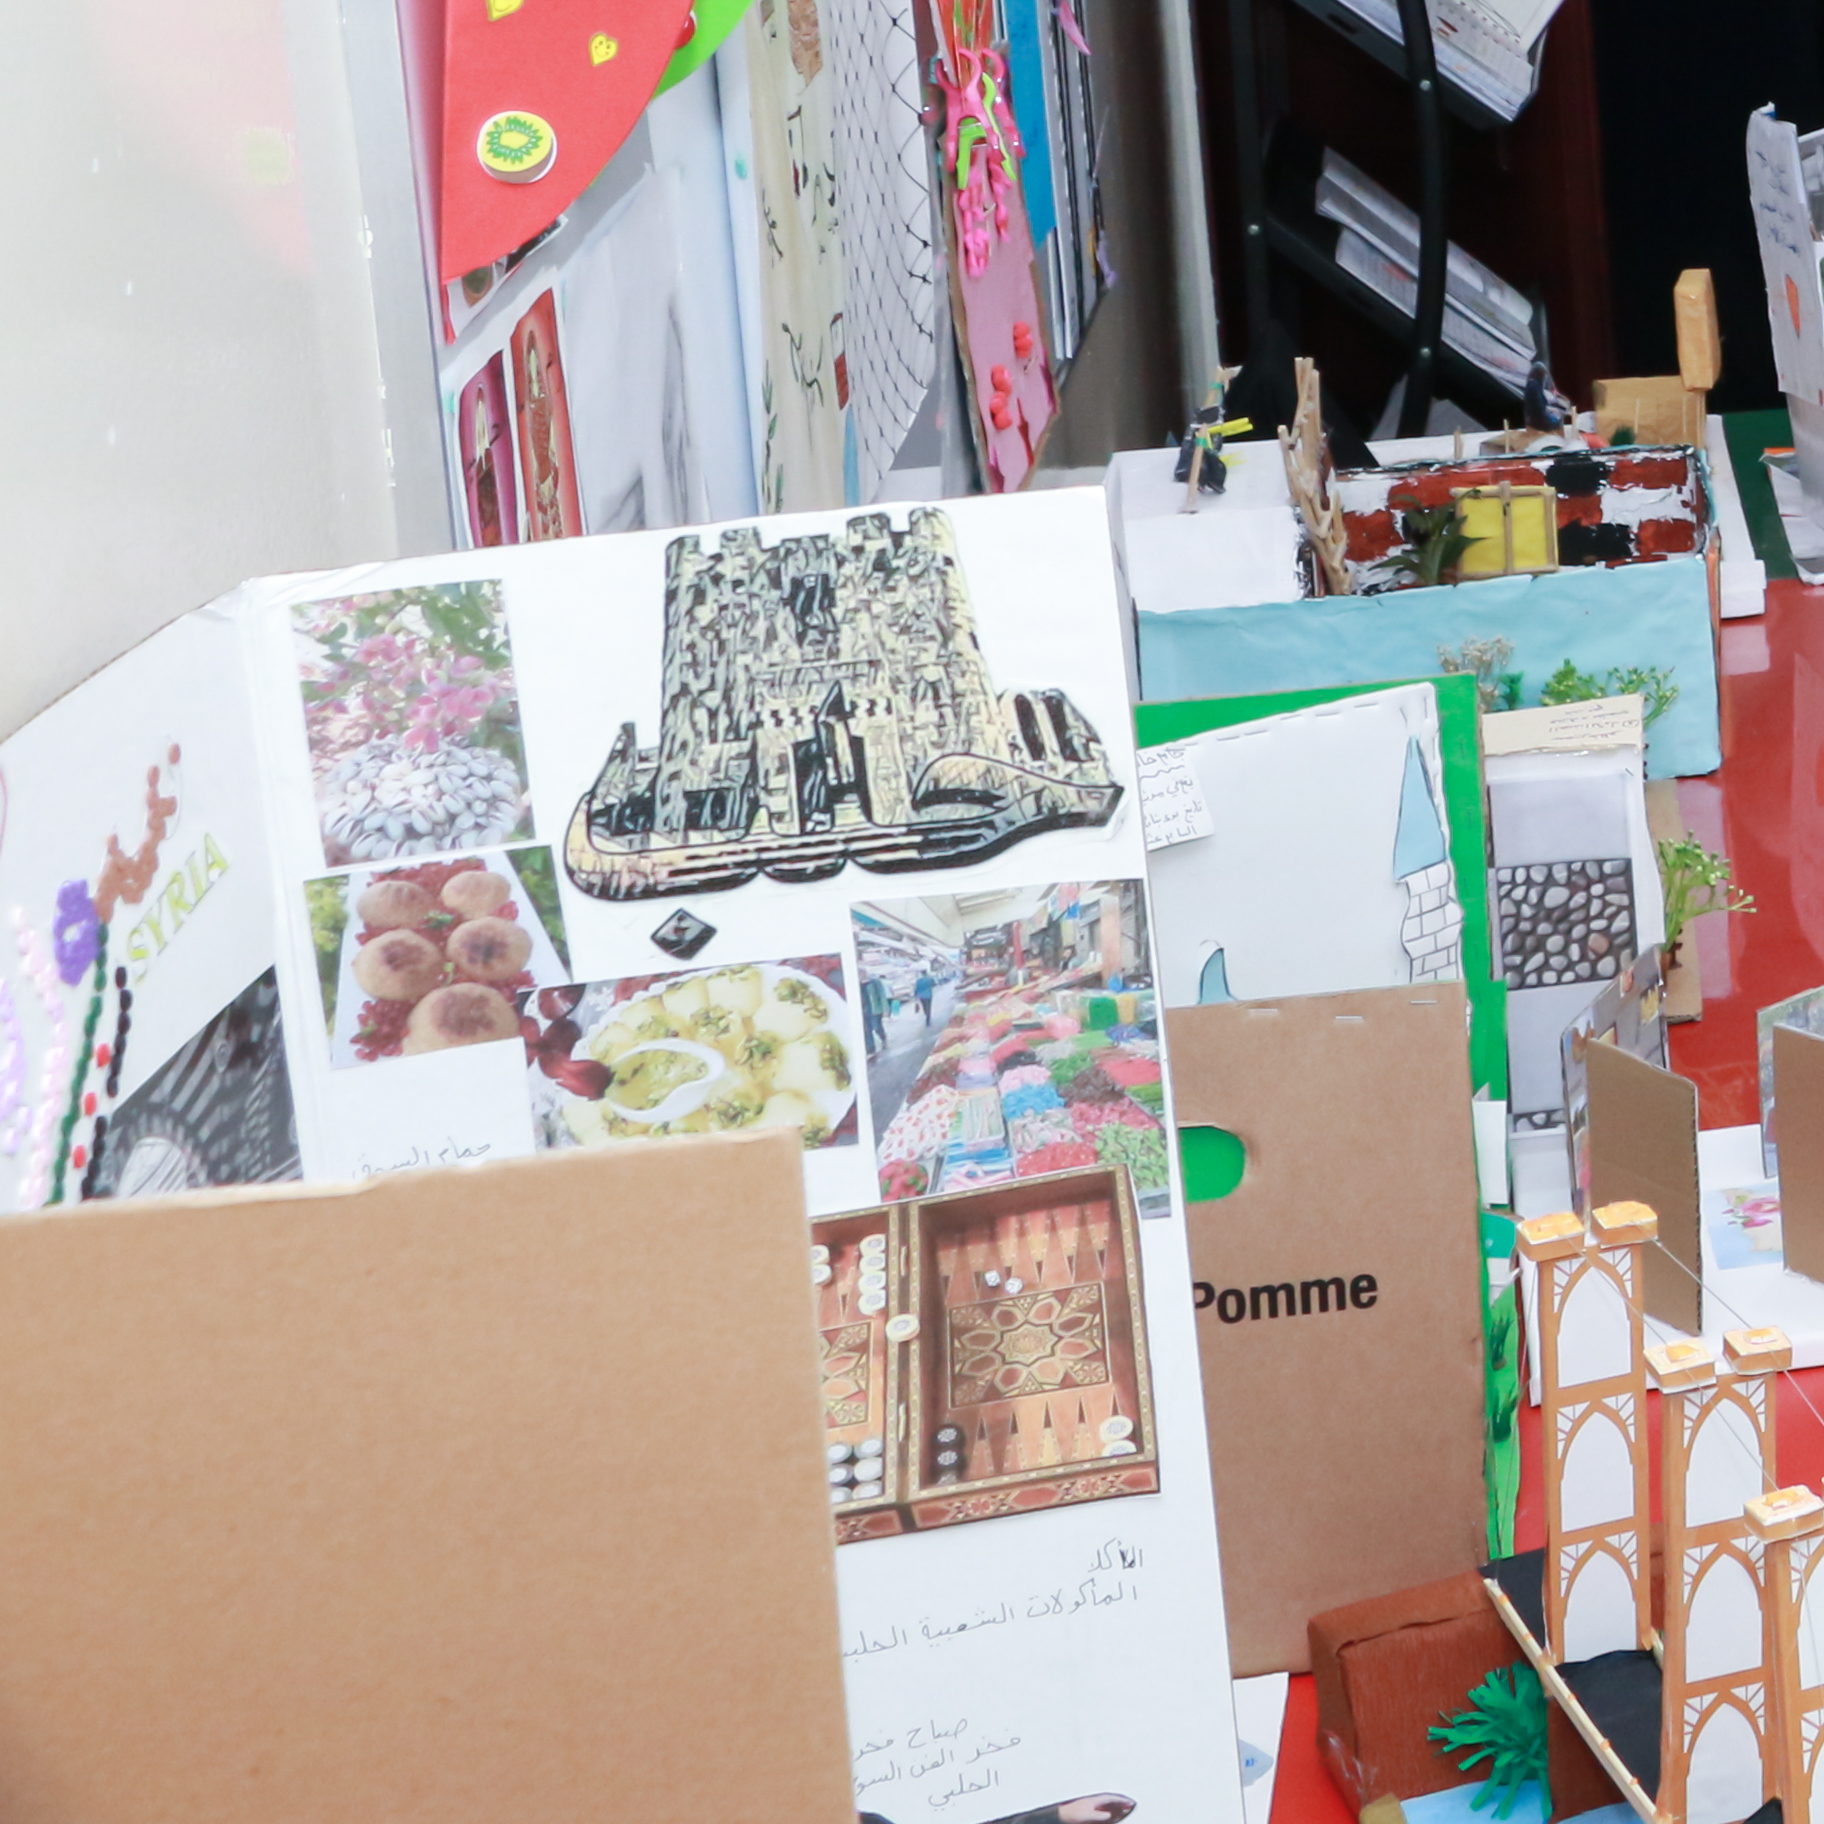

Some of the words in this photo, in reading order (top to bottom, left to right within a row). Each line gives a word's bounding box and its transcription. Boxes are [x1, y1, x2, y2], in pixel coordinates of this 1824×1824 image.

[127, 833, 229, 985] SYRIA
[1193, 1273, 1378, 1325] Pomme
[1027, 1577, 1138, 1619] المأكولات
[919, 1602, 1016, 1648] الشعبية
[907, 1717, 968, 1749] صباح
[927, 1768, 999, 1812] الحلبي
